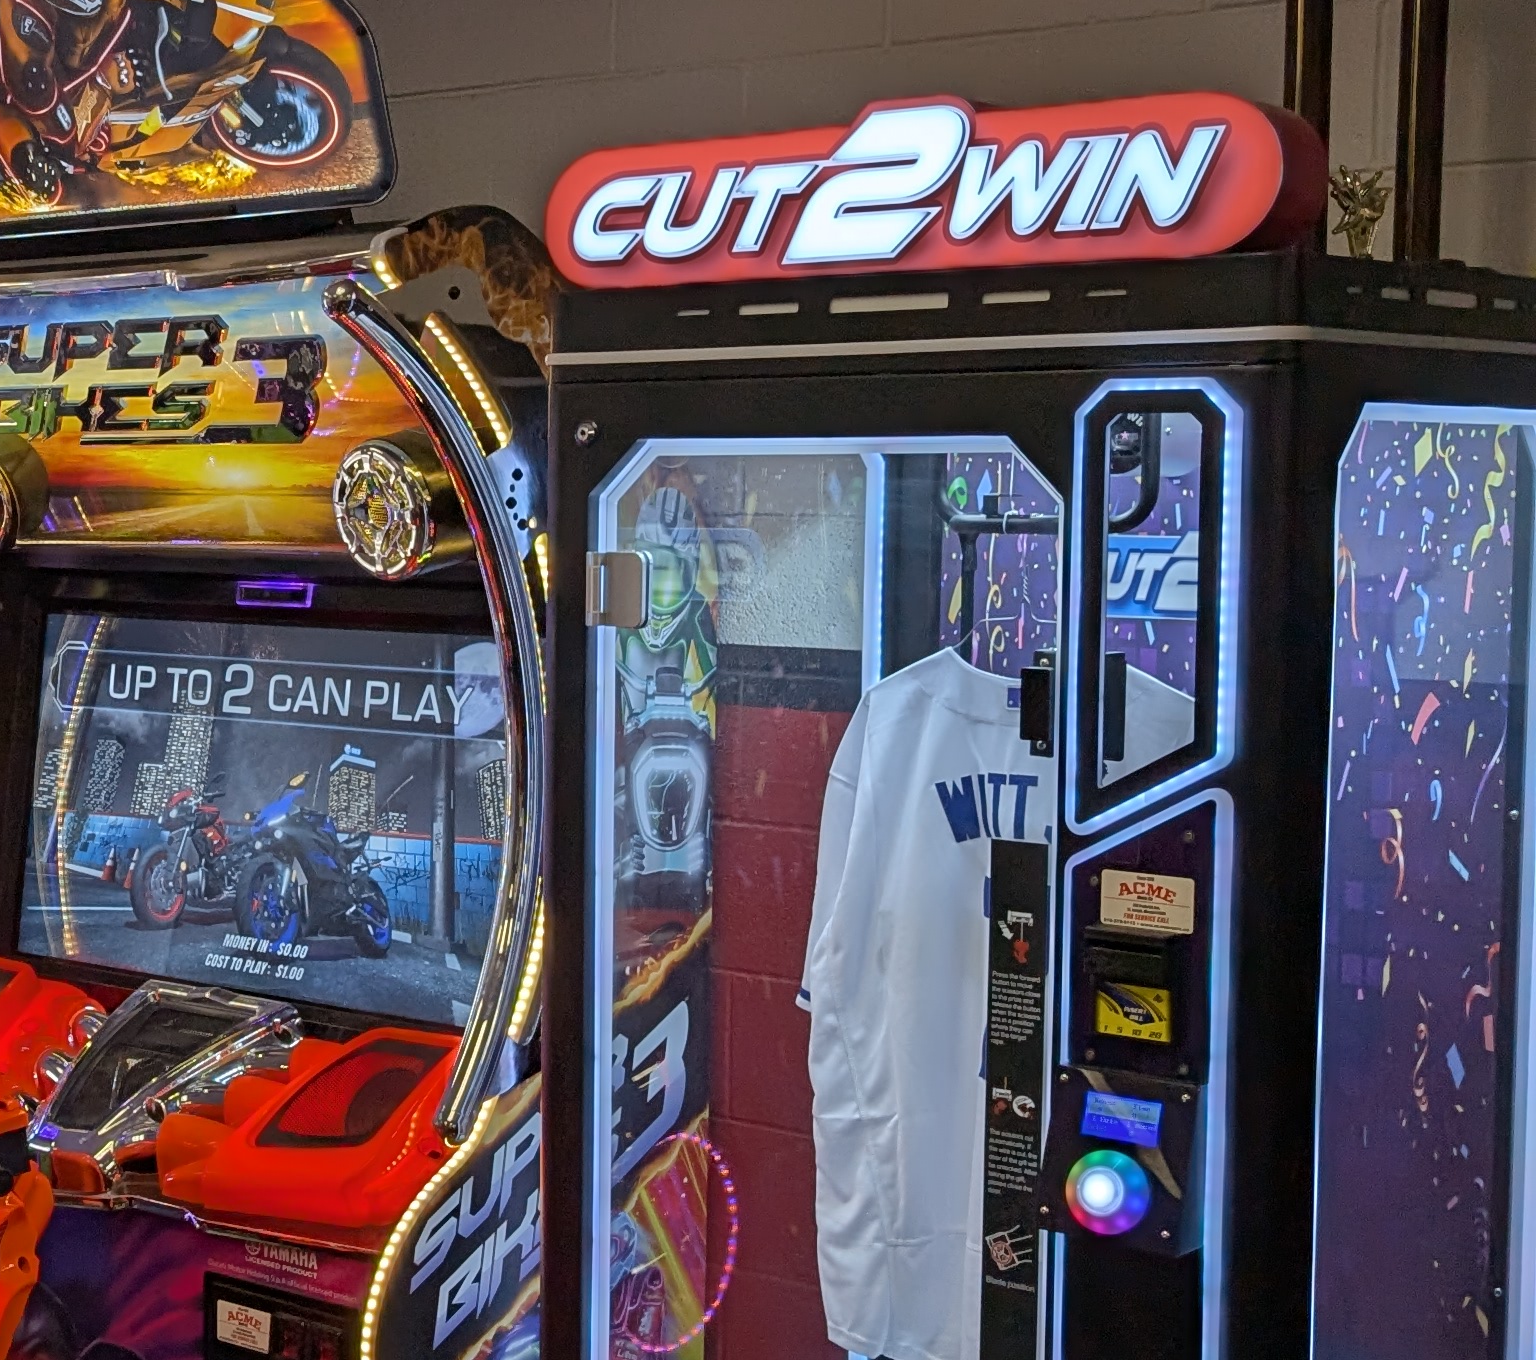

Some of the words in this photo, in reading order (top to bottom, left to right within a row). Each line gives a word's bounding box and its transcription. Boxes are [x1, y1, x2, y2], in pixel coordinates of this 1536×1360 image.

[233, 334, 327, 444] 3
[1107, 530, 1199, 612] UT2
[108, 663, 156, 701] UP
[166, 667, 213, 706] TO
[222, 663, 255, 715] 2
[269, 674, 351, 717] CAN
[364, 680, 475, 725] PLAY
[934, 772, 1039, 843] WITT
[1118, 881, 1177, 904] ACME
[204, 953, 231, 970] COST
[229, 956, 243, 972] TO
[275, 963, 305, 981] $1.00
[222, 933, 258, 952] MONEY
[276, 942, 309, 959] $0.00
[614, 998, 690, 1186] 3
[410, 1112, 541, 1295] SUP
[244, 1255, 280, 1271] LICENSED
[282, 1264, 318, 1280] PRODUCT
[262, 1244, 319, 1280] YAMAHA
[432, 1189, 541, 1351] BIK
[227, 1310, 262, 1331] ACME
